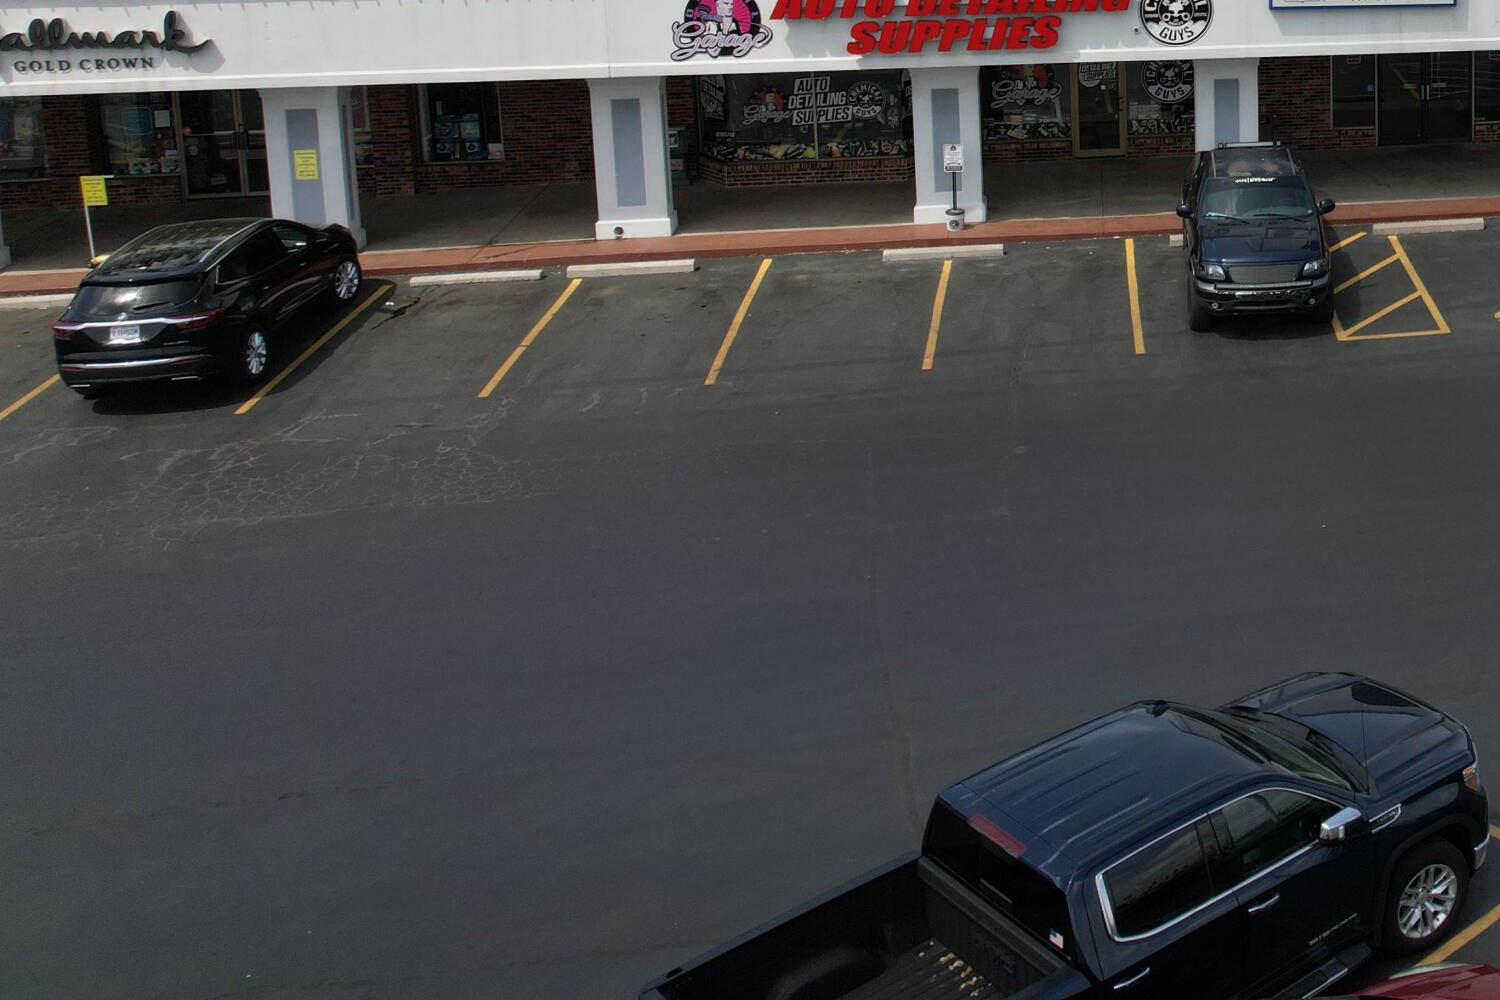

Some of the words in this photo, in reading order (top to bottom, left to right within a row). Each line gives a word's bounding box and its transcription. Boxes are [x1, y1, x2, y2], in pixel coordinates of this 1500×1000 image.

[0, 10, 214, 53] allmark
[671, 21, 773, 61] Garage
[846, 16, 1062, 55] SUPPLIES
[1159, 26, 1194, 41] GUYS
[14, 59, 71, 73] GOLD
[80, 57, 154, 71] CROWN
[849, 84, 883, 102] CHEMICAL
[990, 79, 1062, 109] Garage
[1154, 86, 1185, 99] GUYS
